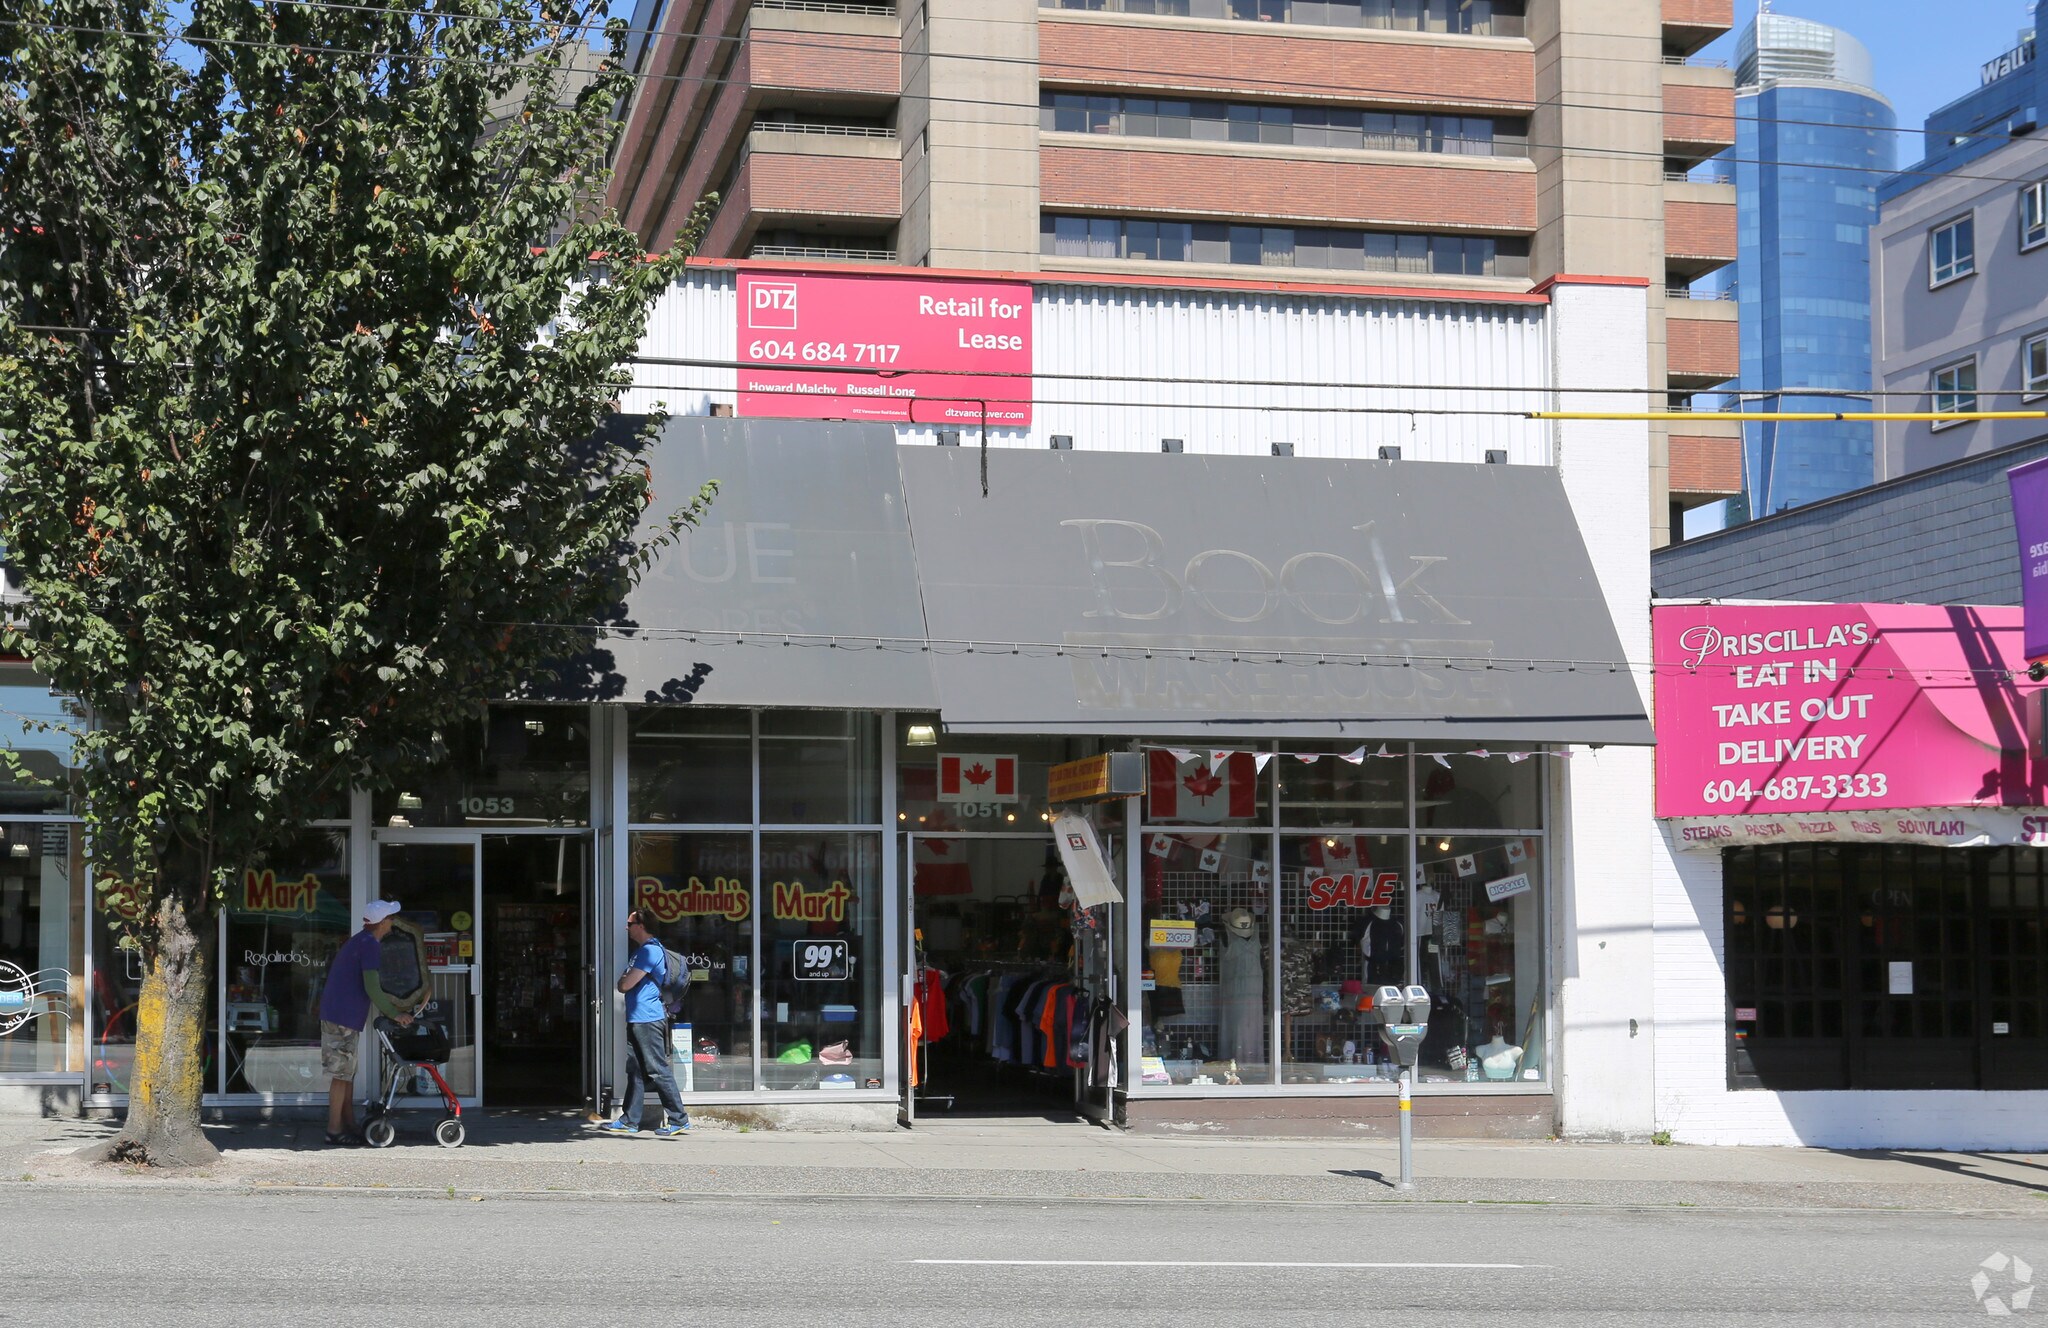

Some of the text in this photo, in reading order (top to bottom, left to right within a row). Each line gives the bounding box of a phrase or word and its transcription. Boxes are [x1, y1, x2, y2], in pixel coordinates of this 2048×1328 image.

[1981, 46, 2026, 85] Wall
[755, 288, 795, 310] DTZ
[919, 295, 1022, 319] Retail for
[958, 328, 1022, 350] Lease
[749, 340, 900, 363] 604 684 7117
[749, 382, 793, 393] Howard
[847, 384, 886, 396] Russell
[889, 386, 916, 398] Long
[1679, 623, 1869, 669] PRISCILLA'S
[1735, 658, 1837, 689] EAT IN
[1712, 694, 1874, 728] TAKE OUT
[1718, 734, 1868, 766] DELIVERY
[1702, 772, 1888, 804] 604-687-3333
[457, 797, 515, 815] 1053
[953, 802, 1002, 818] 1051
[1682, 824, 1733, 841] STEAKS
[1745, 822, 1786, 836] PASTA
[1897, 819, 1965, 836] SOUVLAKI
[243, 868, 321, 913] Mart
[1308, 873, 1399, 911] SALE
[1490, 878, 1526, 896] BIG SALE
[635, 876, 850, 923] Rosalinda's Mart
[1174, 933, 1192, 943] OFF
[809, 970, 821, 978] and
[5, 1014, 22, 1030] 2015
